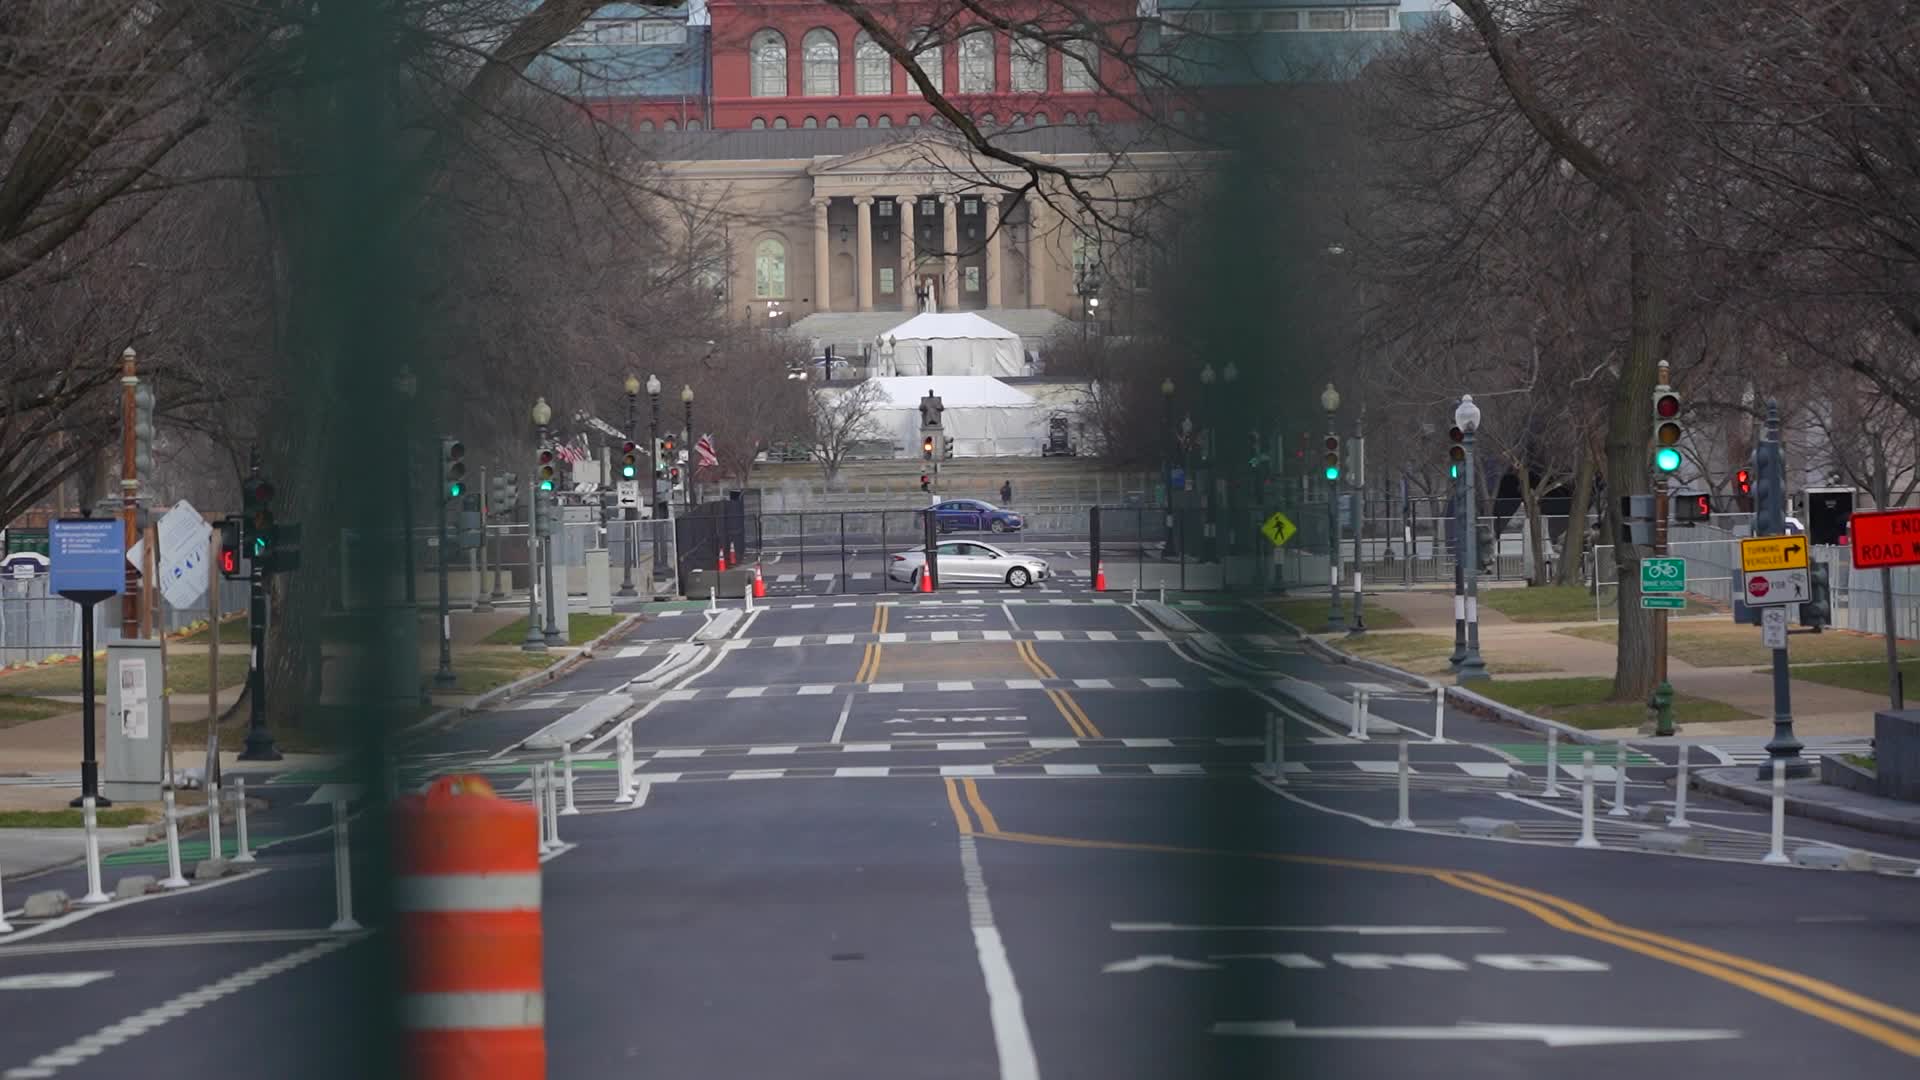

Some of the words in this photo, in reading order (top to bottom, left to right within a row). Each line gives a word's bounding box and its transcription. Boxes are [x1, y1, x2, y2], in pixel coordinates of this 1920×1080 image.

[1891, 517, 1920, 535] END
[1746, 544, 1780, 556] TURNING
[1861, 543, 1904, 561] ROAD
[1745, 556, 1783, 567] VEHICLES
[1749, 582, 1769, 592] STOP
[1771, 581, 1785, 590] FOR
